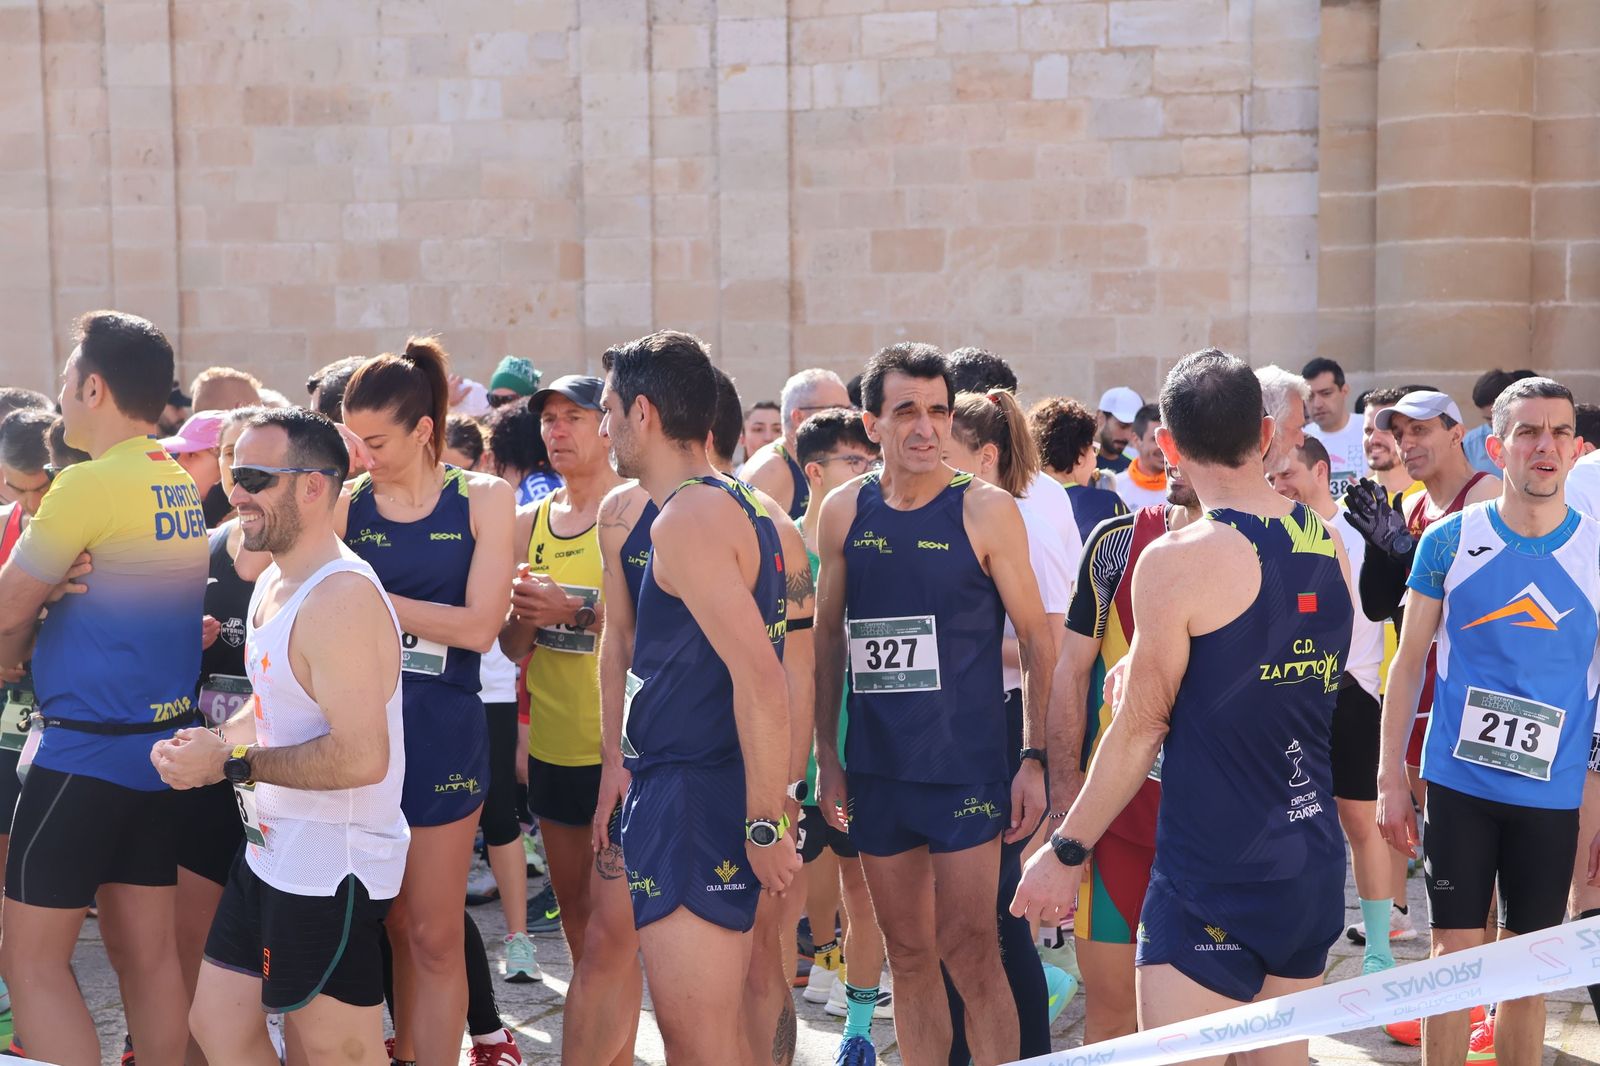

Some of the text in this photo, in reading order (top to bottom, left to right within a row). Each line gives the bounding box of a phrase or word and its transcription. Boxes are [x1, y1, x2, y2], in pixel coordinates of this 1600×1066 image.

[155, 509, 207, 541] DUER
[865, 638, 917, 670] 327
[1478, 712, 1541, 753] 213
[706, 883, 746, 892] CAJA RURAL
[1216, 943, 1241, 951] RURAL
